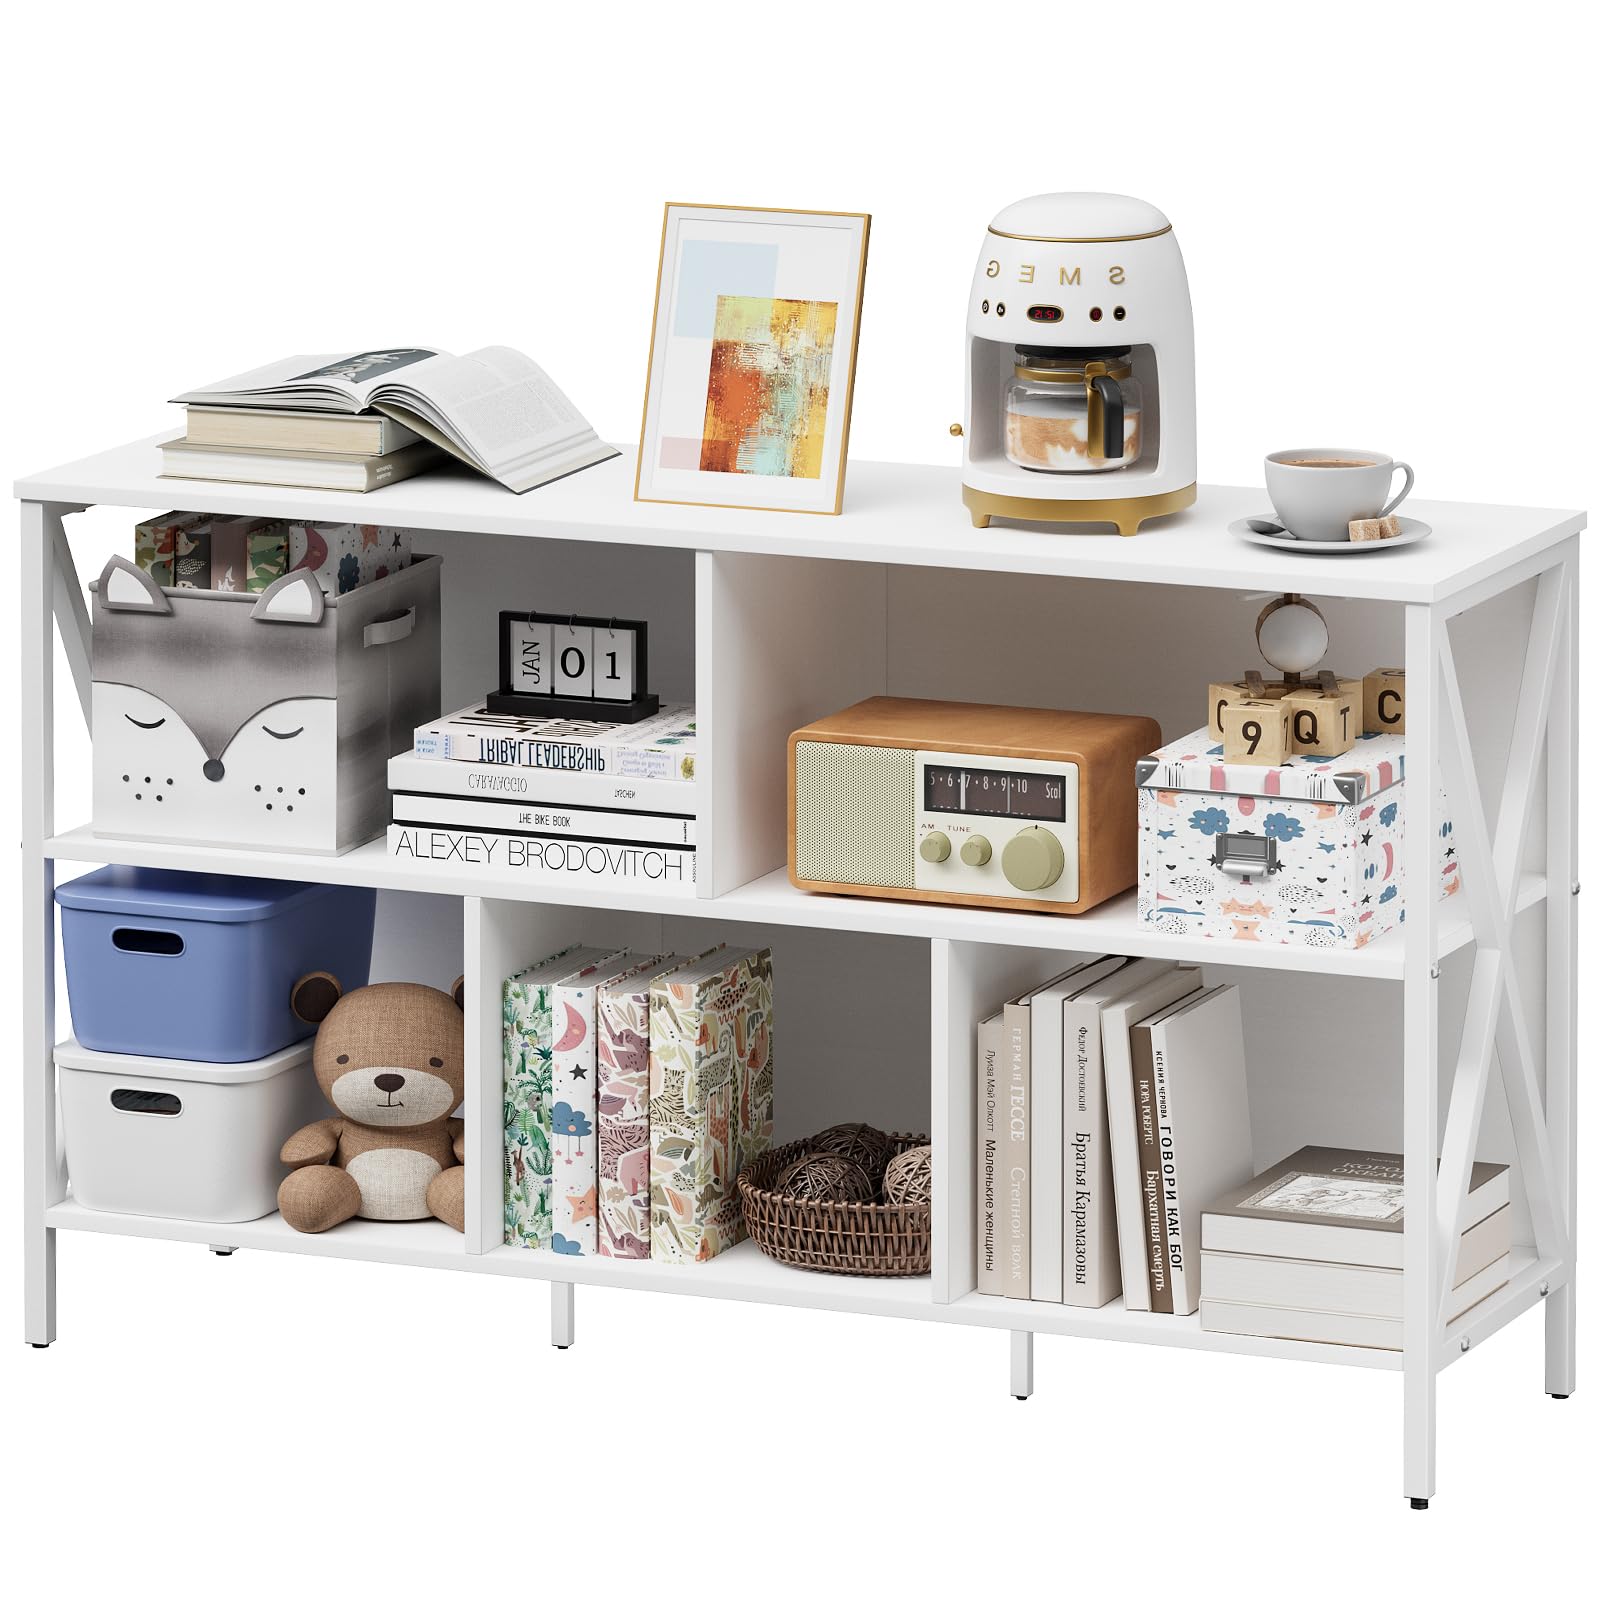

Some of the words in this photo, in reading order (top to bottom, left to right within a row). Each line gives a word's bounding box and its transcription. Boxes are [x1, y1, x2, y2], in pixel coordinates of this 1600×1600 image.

[521, 639, 541, 685] JAN
[1377, 689, 1402, 724] C
[1241, 720, 1262, 755] 9
[1293, 709, 1320, 746] Q
[395, 830, 499, 864] ALEXEY
[508, 839, 683, 881] BRODOVITCH
[985, 1050, 996, 1076] Луиза
[1155, 1051, 1164, 1084] КСЕНИЯ
[986, 1078, 996, 1099] Мэй
[1139, 1080, 1150, 1104] НОРА
[986, 1100, 996, 1132] Олкотт
[1010, 1084, 1025, 1142] ГЕССЕ
[1142, 1106, 1153, 1145] РОБЕРТС
[985, 1139, 996, 1209] Маленькие
[1071, 1132, 1091, 1186] Братья
[1160, 1126, 1177, 1200] ГОВОРИ
[1343, 1162, 1404, 1172] КОРО
[1143, 1169, 1161, 1243] Бархатная
[1167, 1207, 1180, 1237] КАК
[984, 1211, 994, 1271] женщины
[1071, 1190, 1091, 1285] Карамазовы
[1151, 1244, 1164, 1292] смерть
[1170, 1244, 1183, 1272] БОГ
